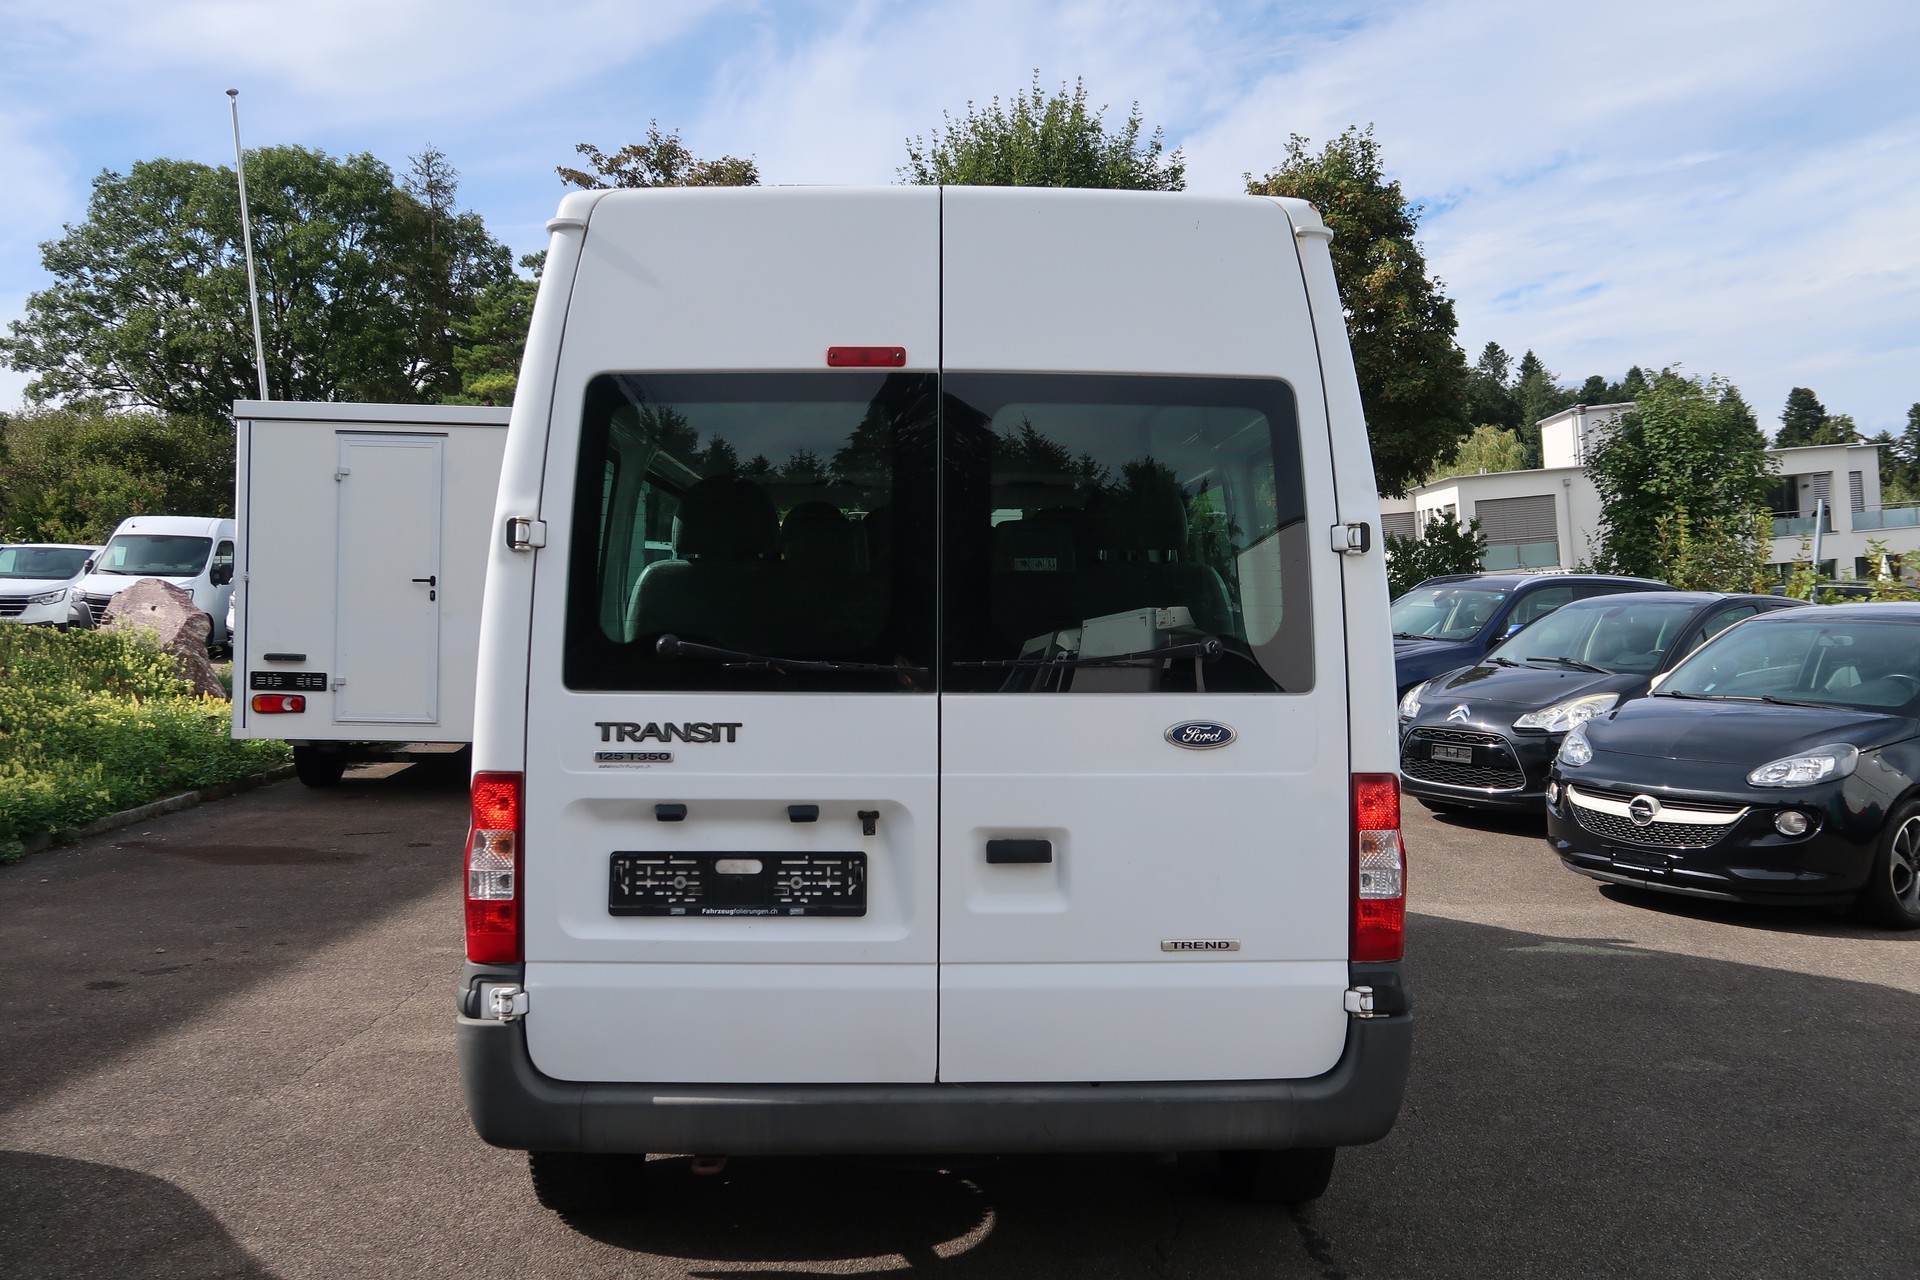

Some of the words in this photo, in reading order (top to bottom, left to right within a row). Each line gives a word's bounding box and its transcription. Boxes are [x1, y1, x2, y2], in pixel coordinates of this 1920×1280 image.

[595, 722, 742, 742] TRANSIT
[1182, 726, 1222, 742] Ford
[597, 752, 623, 760] 125
[628, 752, 670, 760] T350
[702, 908, 778, 916] Fahrzeugfolierungen.ch
